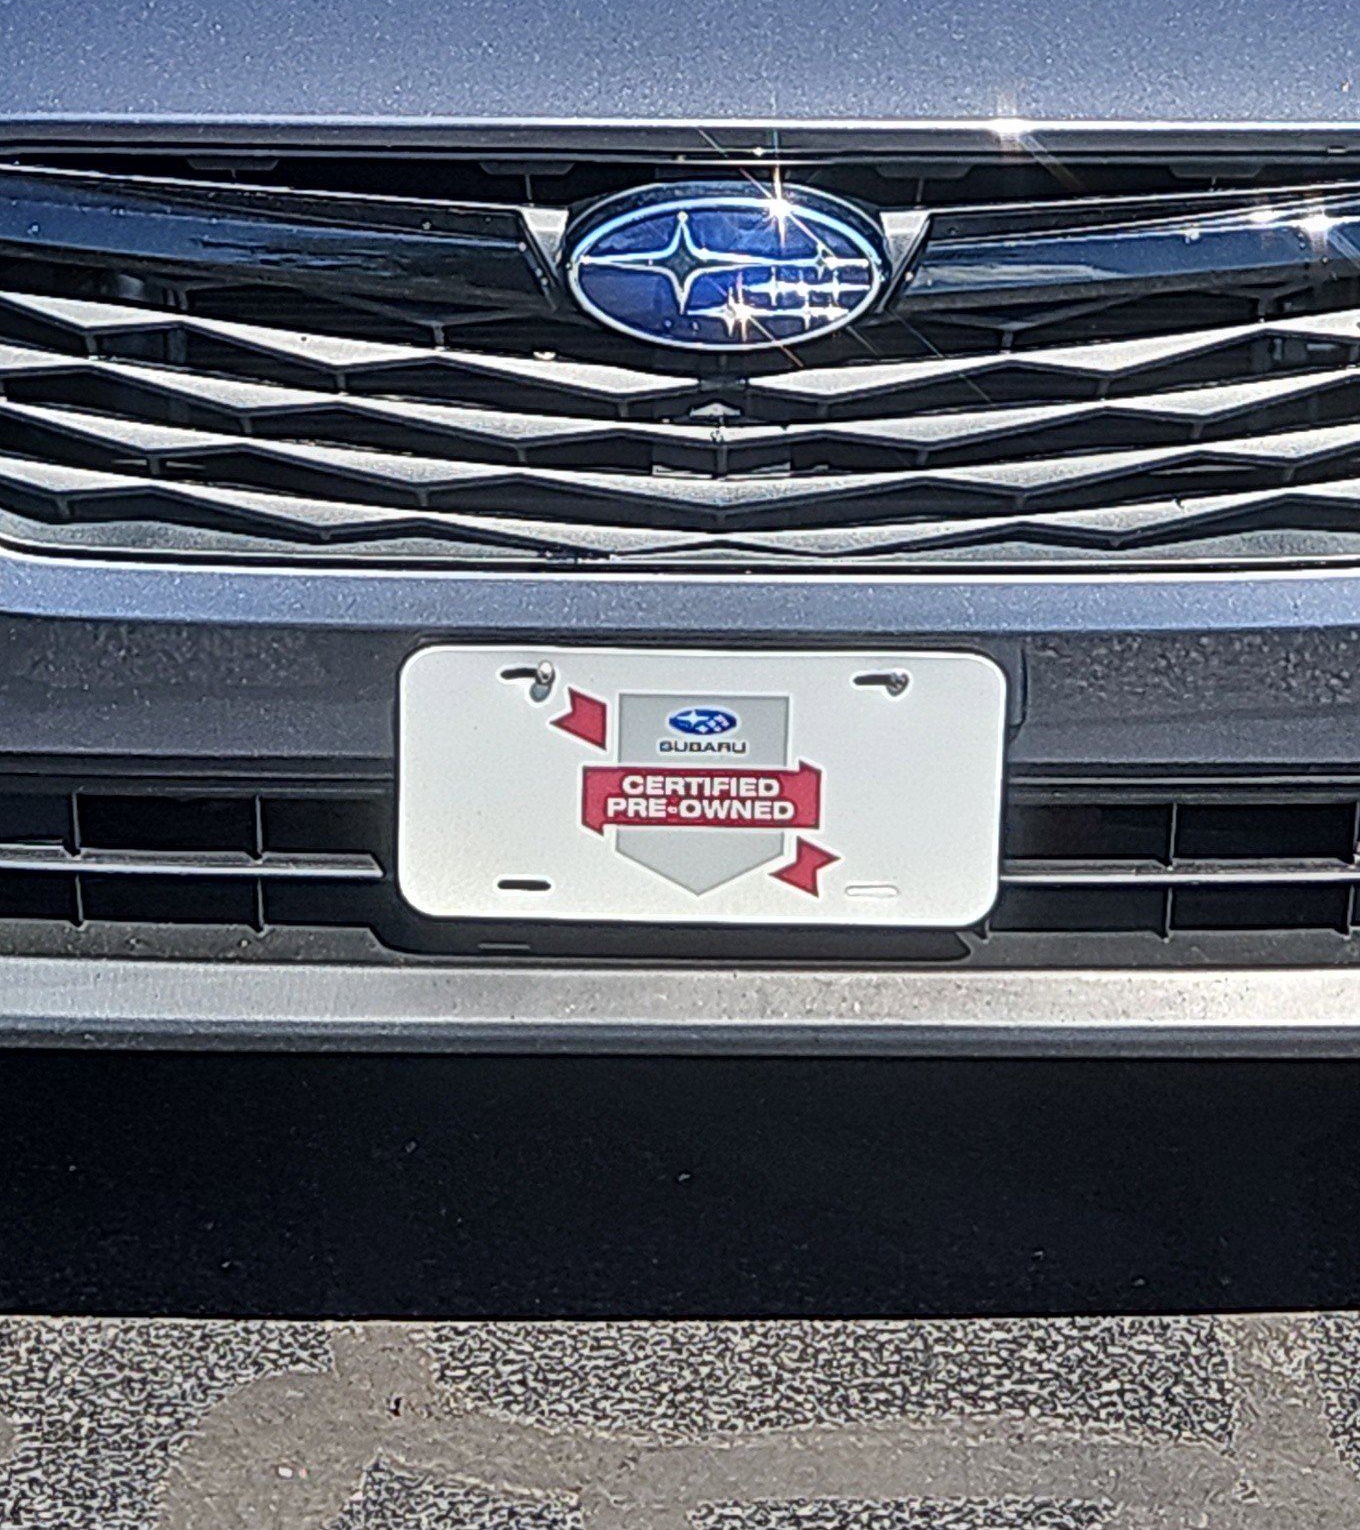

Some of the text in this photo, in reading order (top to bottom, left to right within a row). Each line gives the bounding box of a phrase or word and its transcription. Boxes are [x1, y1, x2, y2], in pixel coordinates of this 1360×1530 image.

[659, 739, 746, 755] SUBARU
[622, 774, 780, 798] CERTIFIED
[606, 797, 795, 821] PRE-OWNED
